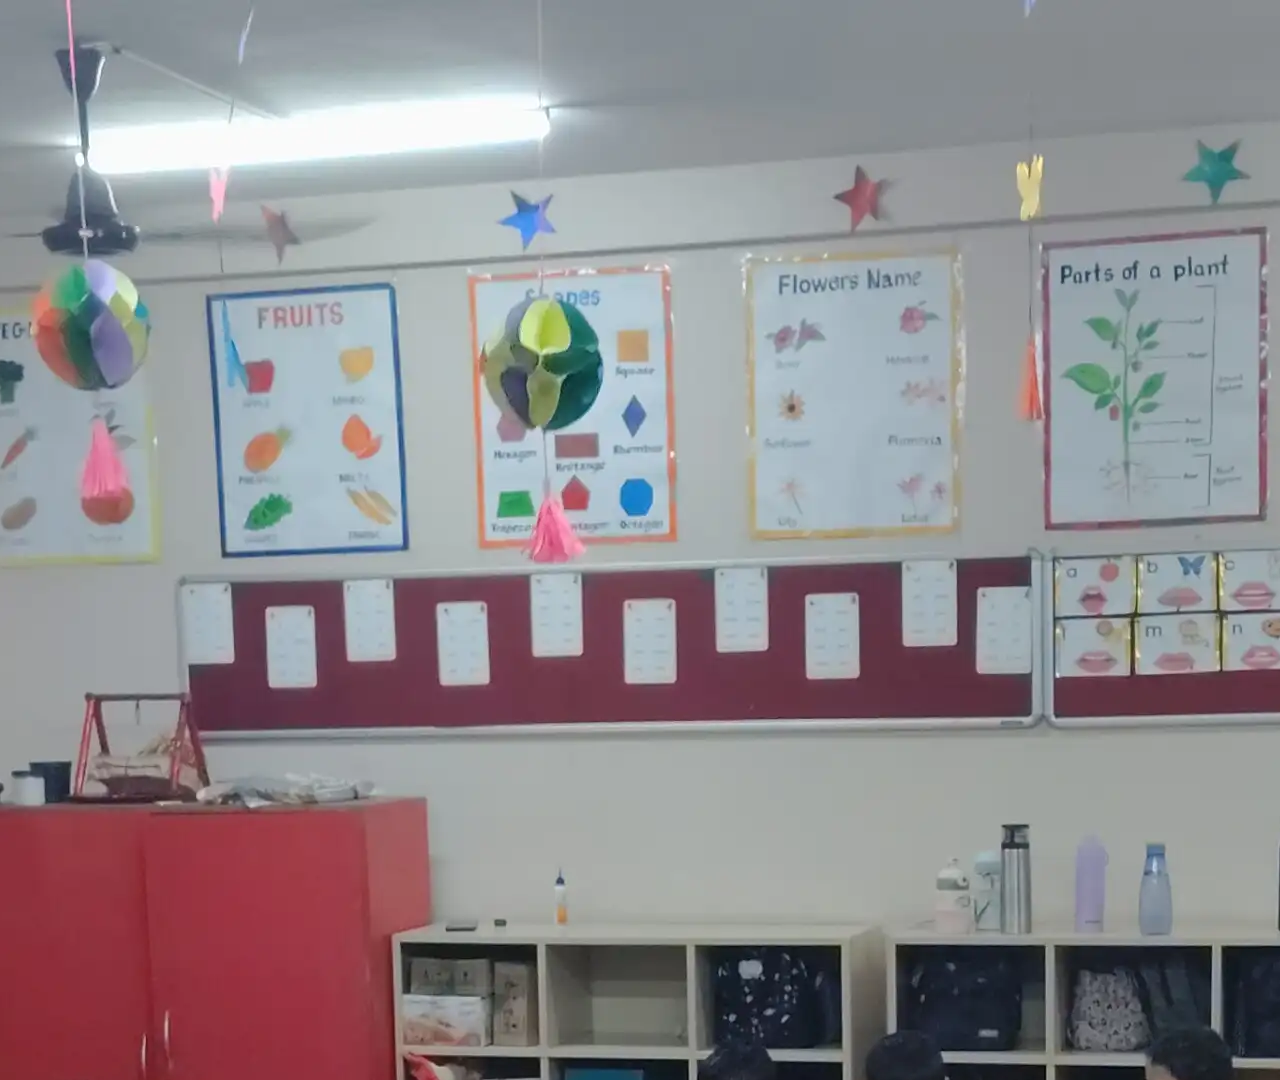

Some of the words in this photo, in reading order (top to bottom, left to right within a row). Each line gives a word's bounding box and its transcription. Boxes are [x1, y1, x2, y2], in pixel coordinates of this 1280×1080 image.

[1060, 262, 1114, 285] Parts
[1122, 259, 1140, 281] of
[1149, 265, 1161, 280] a
[1173, 254, 1229, 282] plant
[778, 273, 859, 295] Flowers
[867, 268, 922, 290] Name
[257, 301, 344, 329] FRUITS
[1146, 560, 1159, 574] b
[1224, 559, 1235, 571] c
[1066, 566, 1078, 578] a
[1145, 625, 1162, 638] m
[1232, 623, 1243, 635] n
